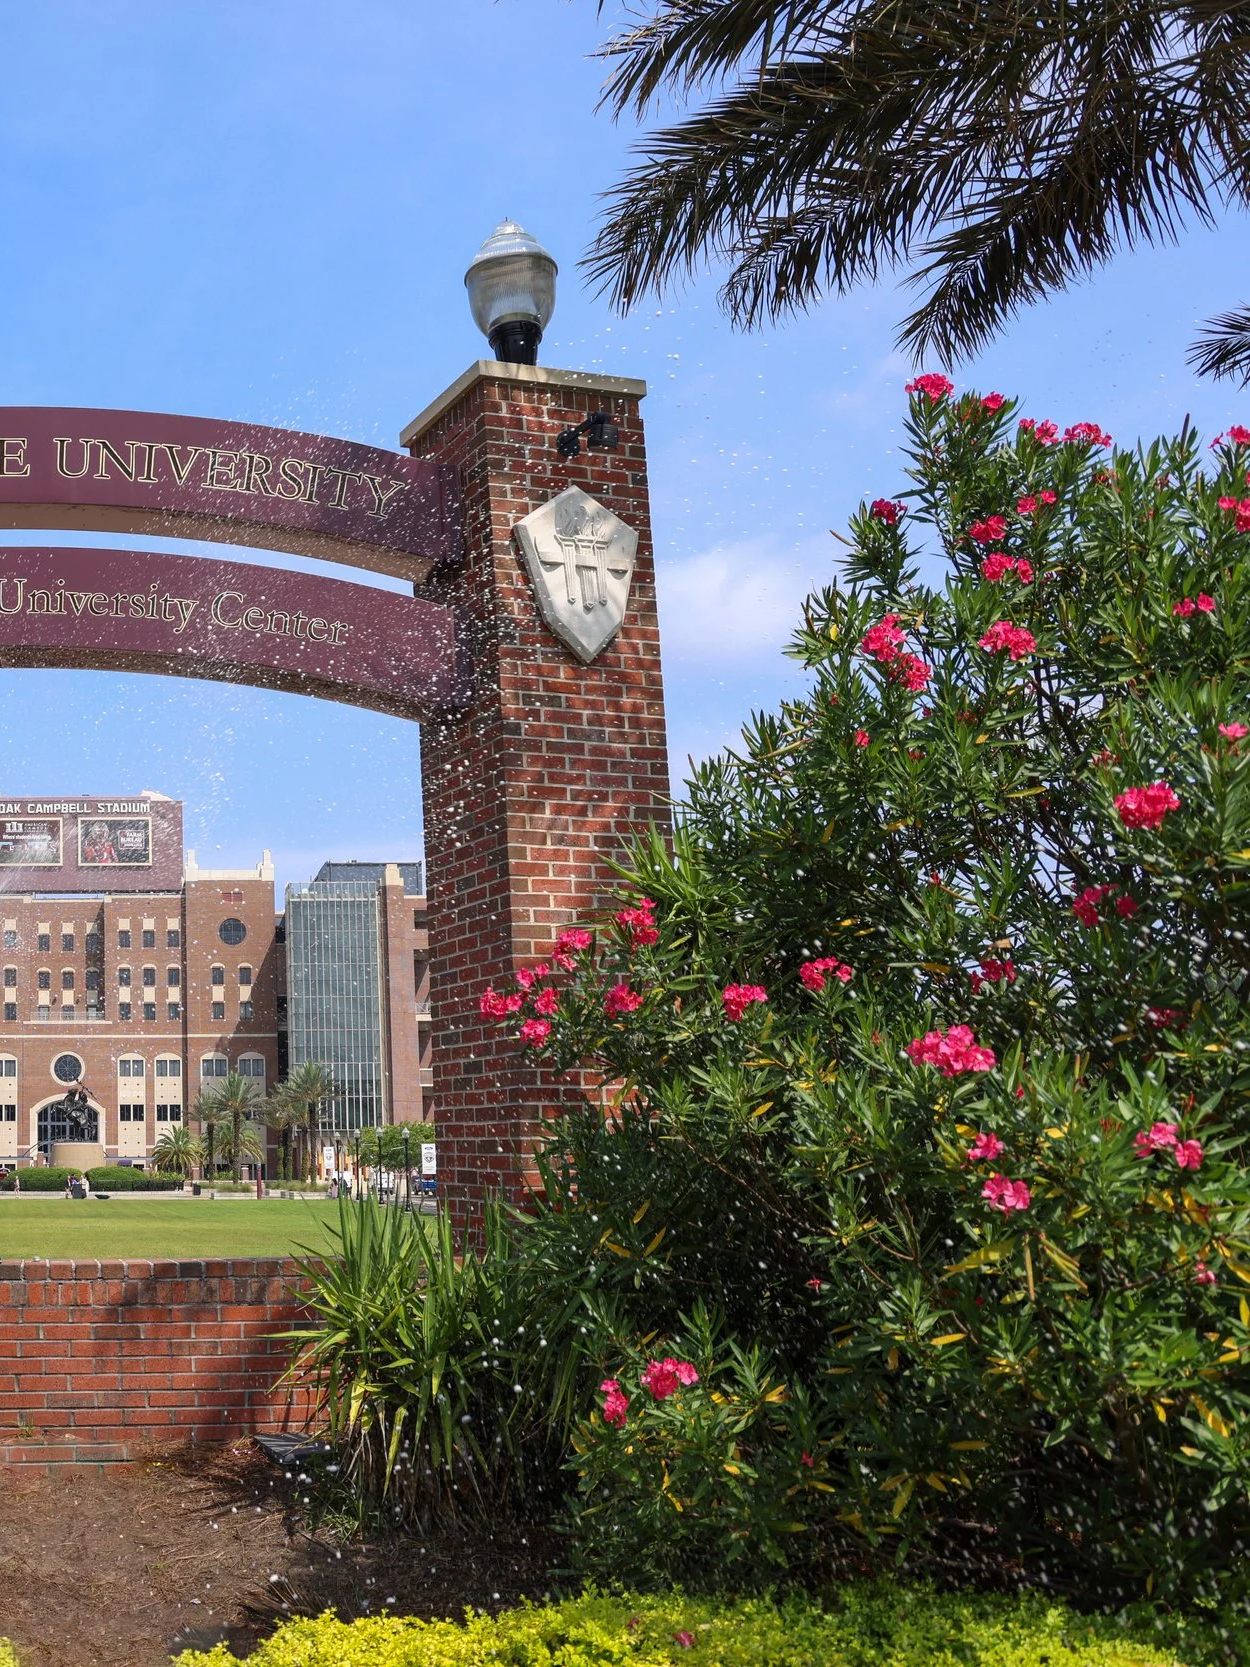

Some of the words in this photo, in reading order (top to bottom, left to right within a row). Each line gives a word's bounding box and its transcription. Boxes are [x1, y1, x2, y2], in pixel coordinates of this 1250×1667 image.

[53, 437, 406, 520] UNIVERSITY
[210, 591, 348, 646] Center
[27, 803, 91, 814] CAMPBELL
[97, 802, 150, 813] STADIUM
